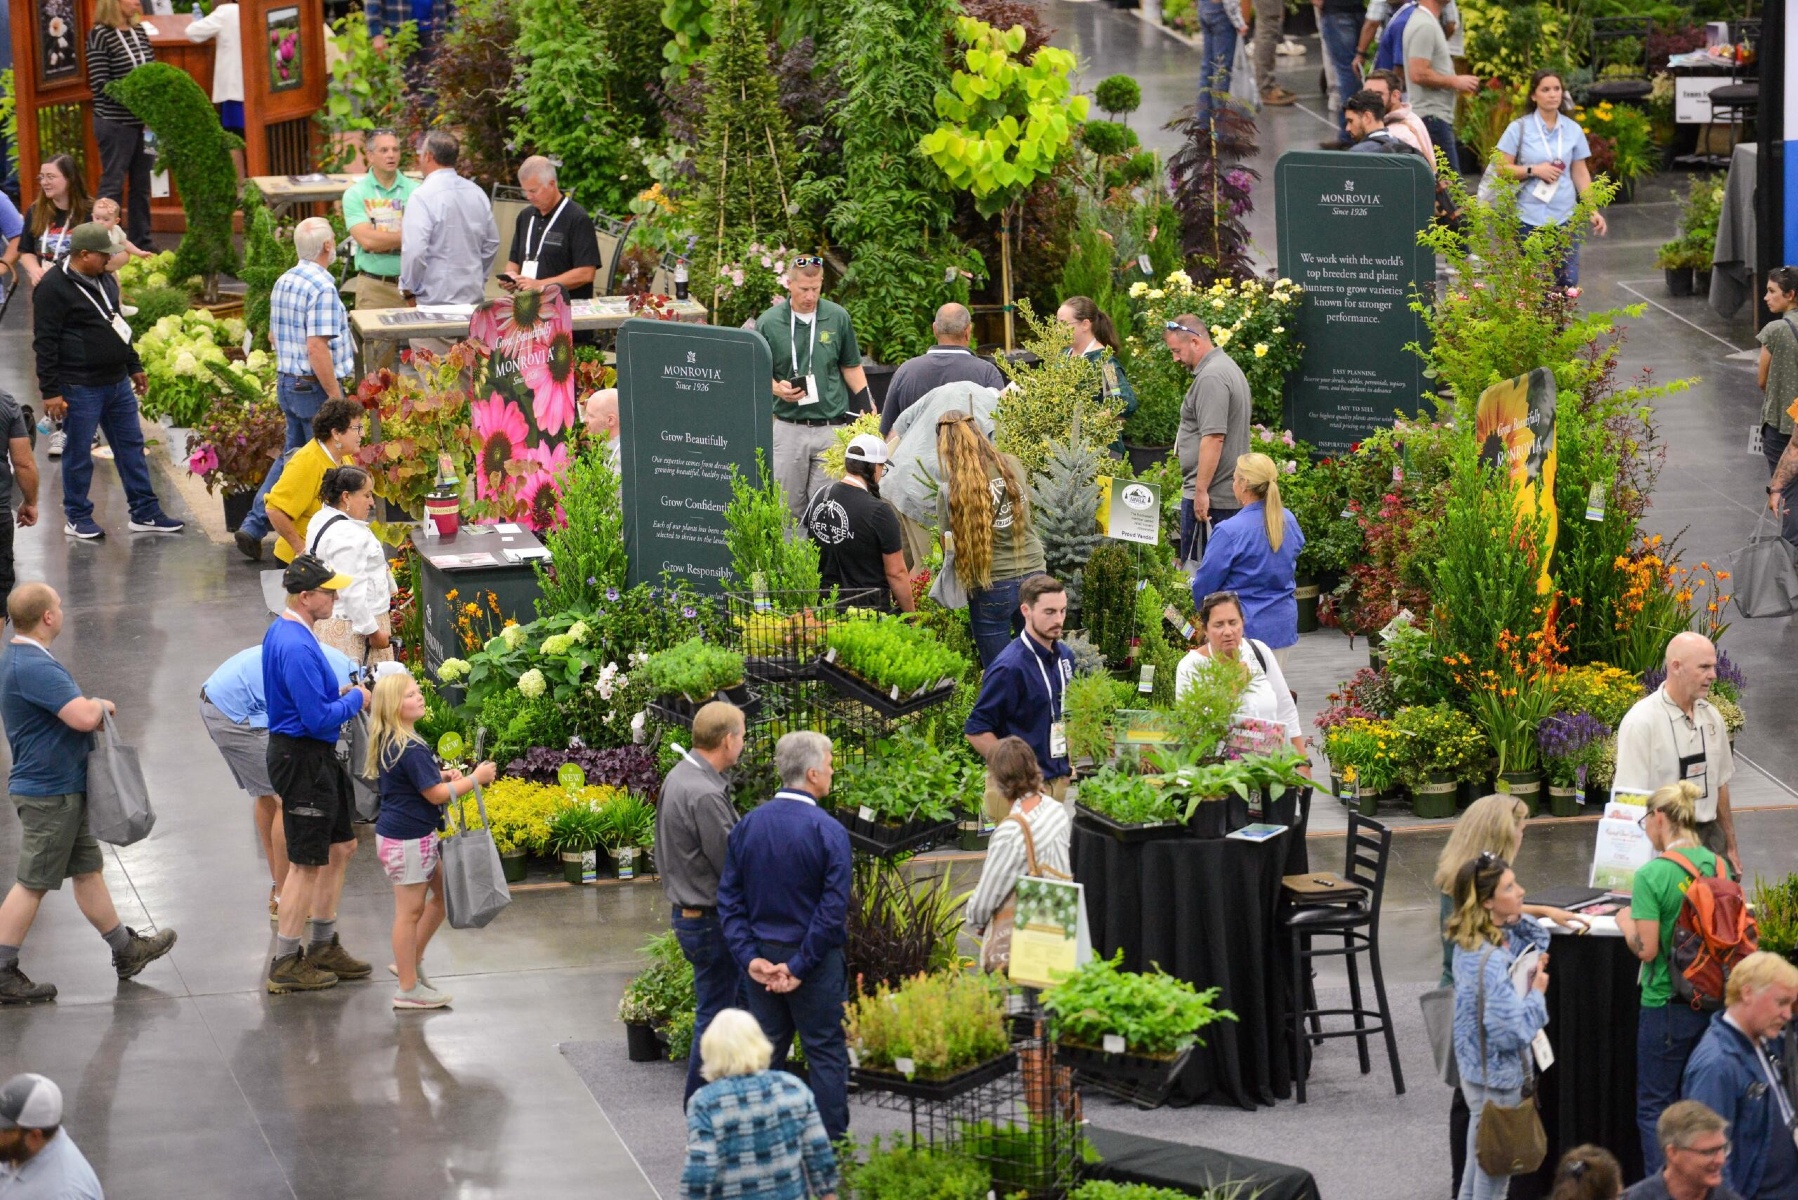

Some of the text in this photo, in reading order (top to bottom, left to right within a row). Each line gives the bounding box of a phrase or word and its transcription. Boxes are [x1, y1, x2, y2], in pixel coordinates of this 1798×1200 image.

[1321, 194, 1380, 204] MONROVIA
[1332, 207, 1367, 216] Since 1926
[1300, 253, 1404, 266] We work with the world's
[1306, 268, 1398, 282] top breeders and plant
[1303, 282, 1403, 296] hunters to grow varieties
[1314, 296, 1392, 312] known for stronger
[1326, 311, 1380, 324] performance.
[516, 321, 552, 343] Beautifully
[496, 346, 554, 378] MONROVIA
[664, 365, 721, 379] MONROVIA
[1347, 369, 1376, 377] PLANNING
[676, 381, 709, 392] Since 1926
[661, 430, 728, 450] Grow Beautifully
[651, 455, 662, 463] Our
[654, 466, 676, 476] growing
[701, 469, 720, 481] healthy
[660, 495, 683, 507] Grow
[652, 520, 665, 528] Each
[666, 521, 673, 530] of
[681, 523, 698, 532] plants
[708, 526, 719, 534] been
[656, 531, 675, 539] selected
[681, 533, 696, 541] thrive
[1121, 530, 1137, 538] Proud
[662, 560, 733, 581] Grow Responsibly
[441, 739, 459, 752] NEW
[562, 774, 581, 782] NEW
